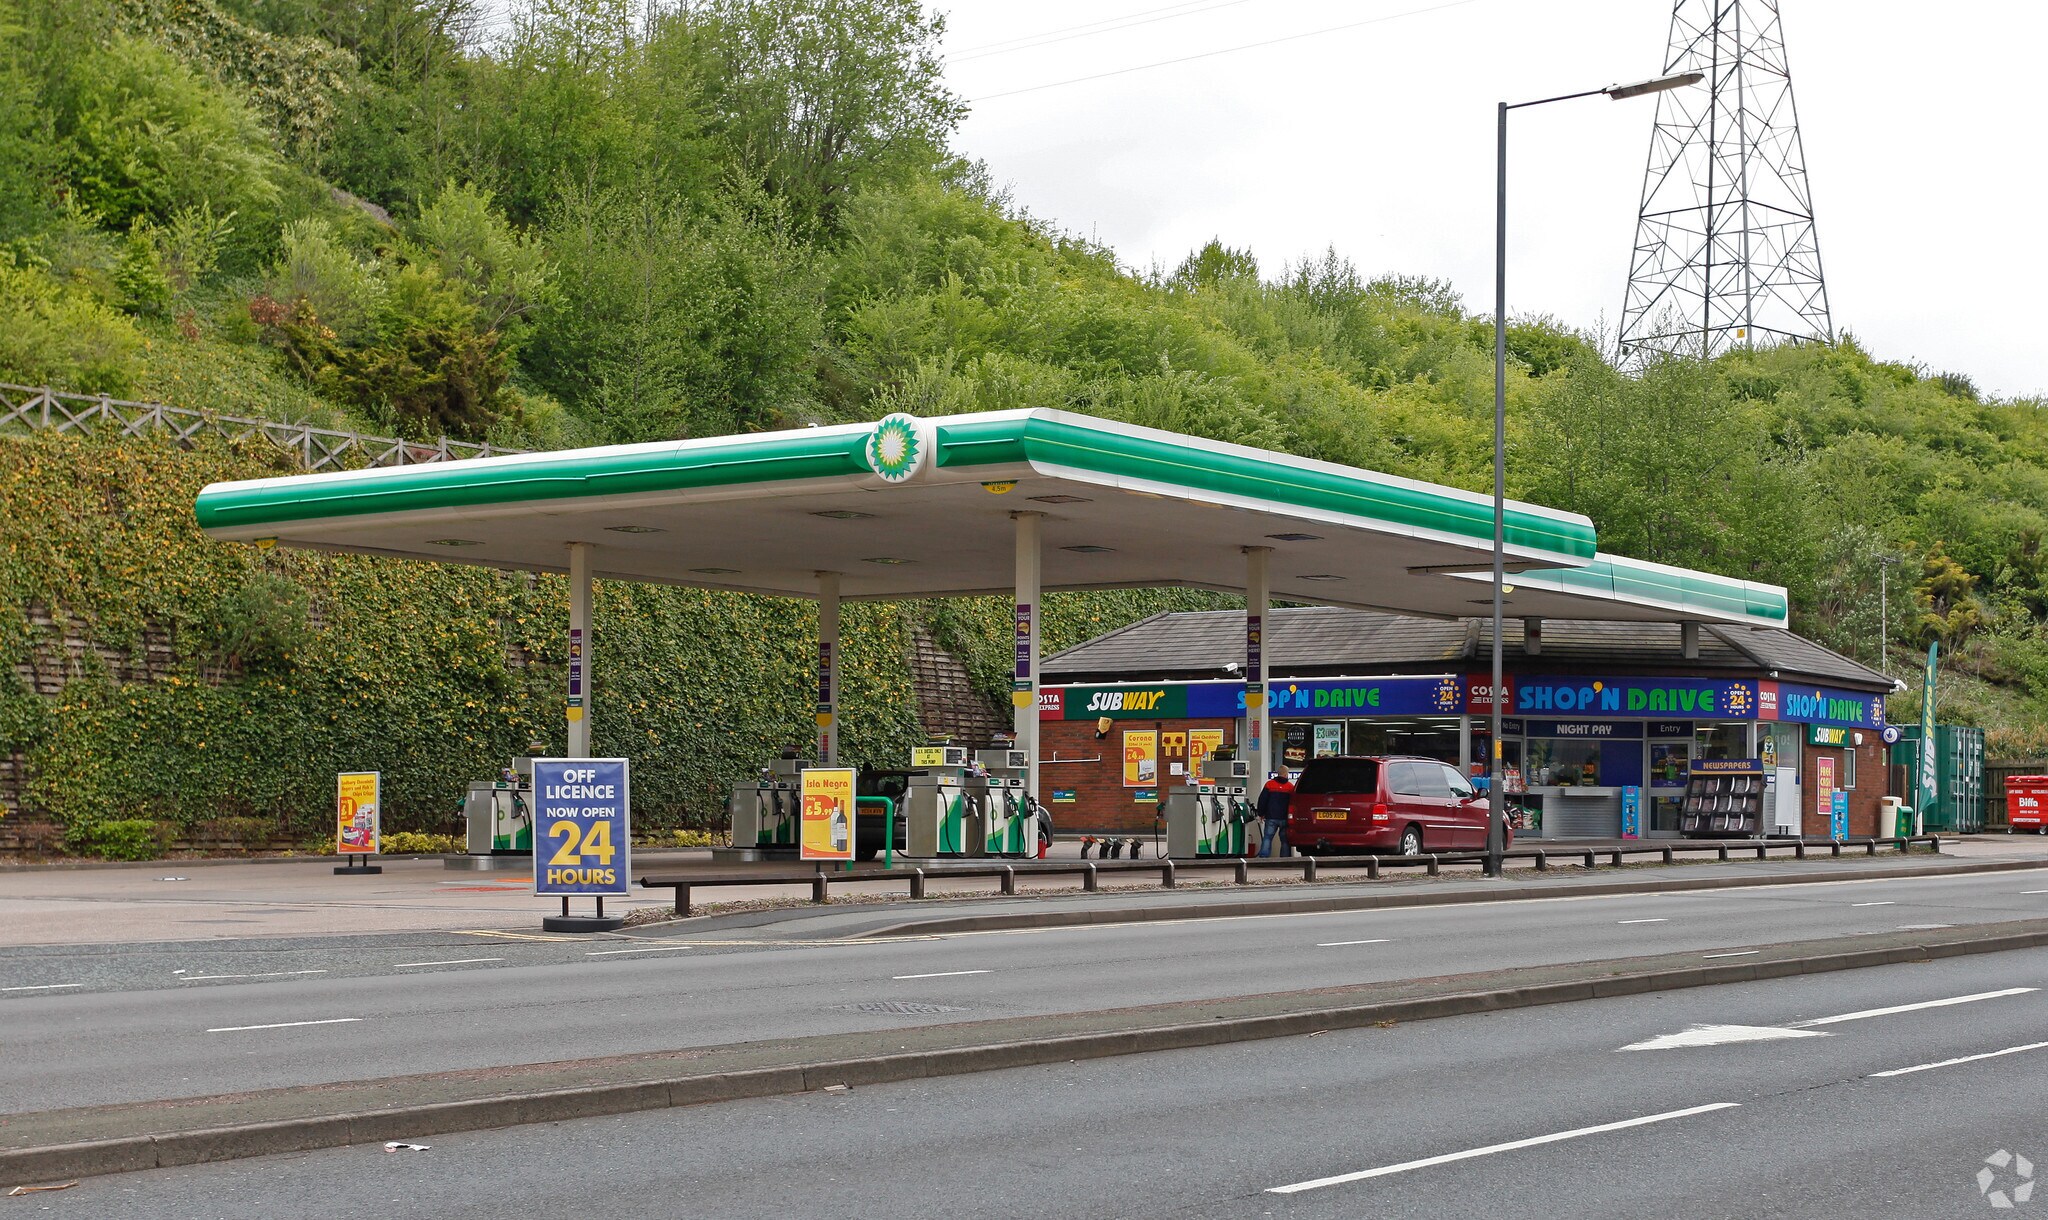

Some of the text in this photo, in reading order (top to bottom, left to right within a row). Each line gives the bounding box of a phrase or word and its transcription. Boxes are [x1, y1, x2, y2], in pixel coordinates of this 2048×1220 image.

[1237, 684, 1380, 709] SOP'N DRIVE
[1440, 691, 1453, 701] 24
[1471, 686, 1509, 697] COSA
[1519, 681, 1715, 712] SHOP'N DRIVE
[1760, 692, 1776, 702] COSTA
[1039, 694, 1060, 704] OSTA
[1087, 690, 1165, 711] SUBWAY
[1730, 695, 1746, 705] 24
[1787, 691, 1863, 722] SHOP'N DRIVE
[1509, 722, 1520, 731] Entry
[1557, 725, 1612, 734] NIGHT PAY
[1660, 725, 1681, 733] Entry
[1316, 728, 1325, 739] £3
[1815, 727, 1845, 744] SUBWAY
[563, 769, 596, 783] OFF
[823, 780, 848, 789] Negra
[546, 785, 615, 799] LICENCE
[2019, 798, 2038, 807] Biffa
[547, 807, 615, 817] NOW OPEN
[806, 801, 832, 816] £5.99
[548, 820, 616, 865] 24
[547, 869, 616, 885] HOURS
